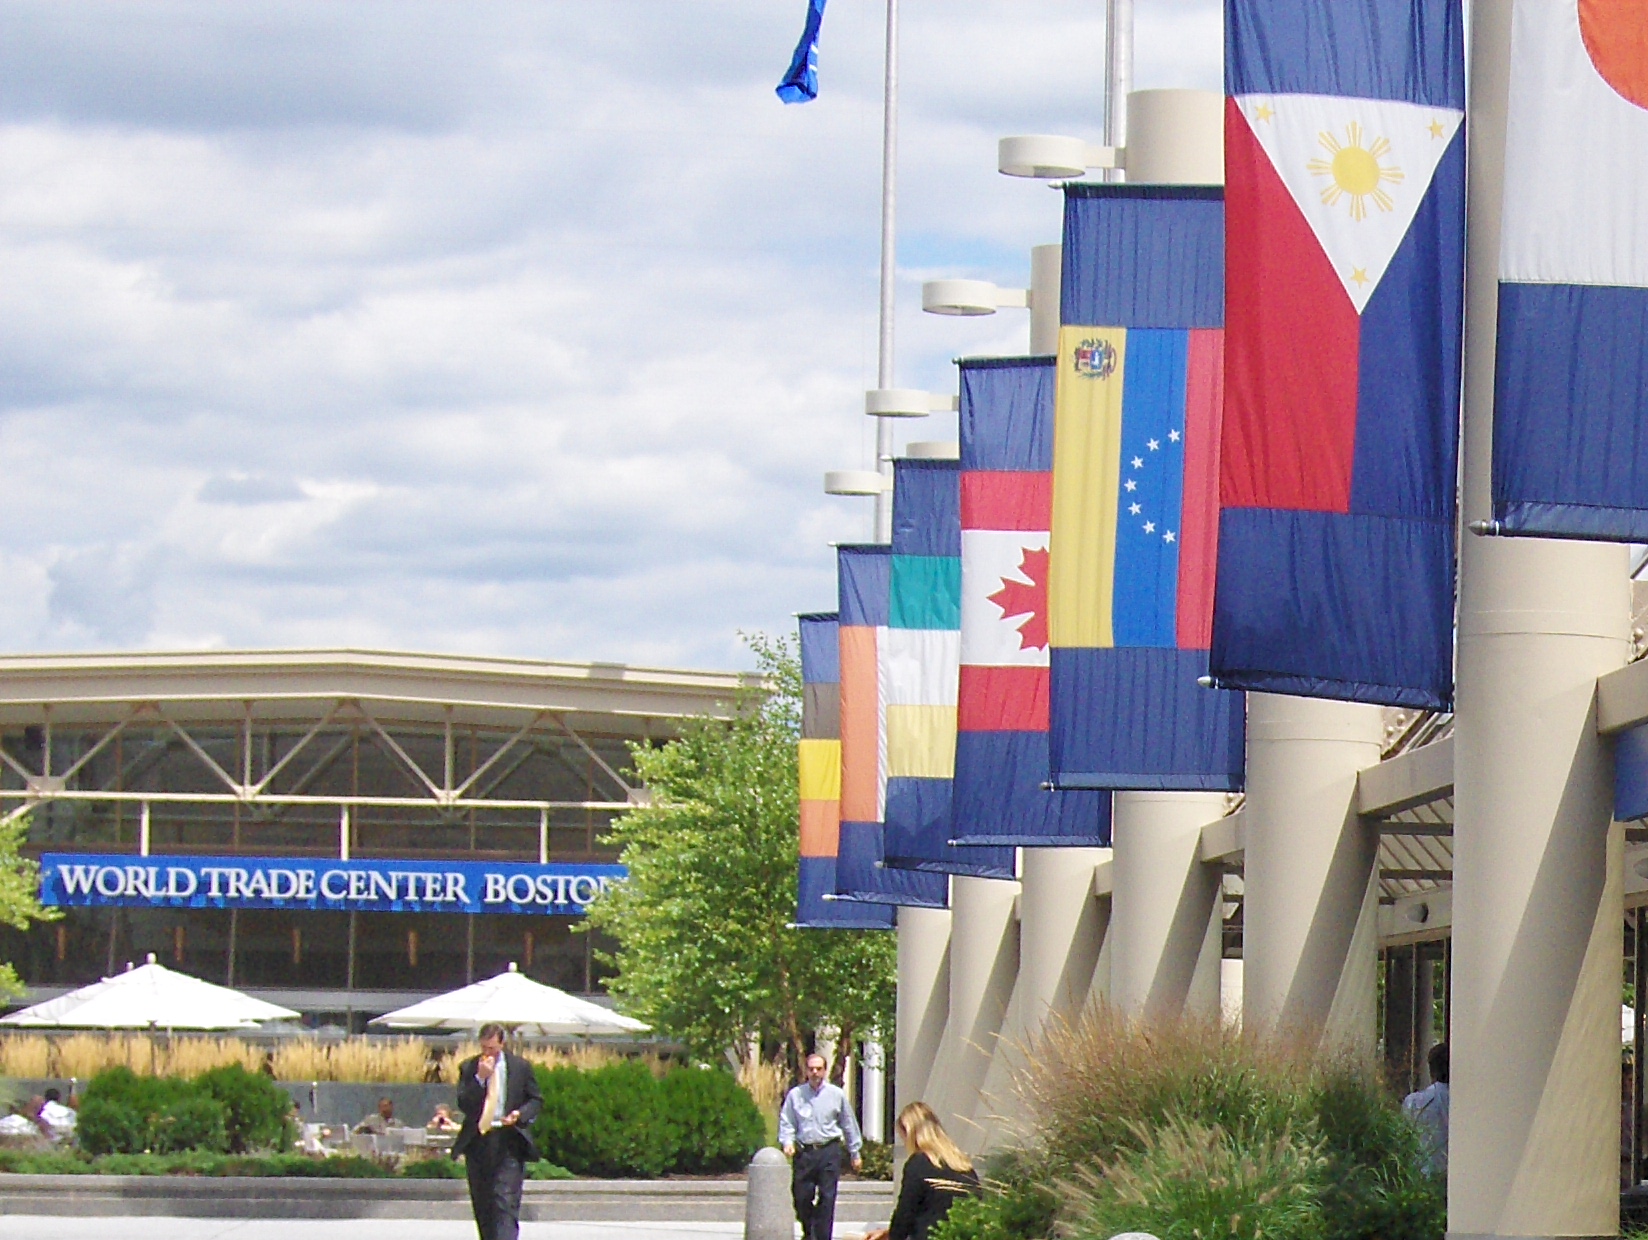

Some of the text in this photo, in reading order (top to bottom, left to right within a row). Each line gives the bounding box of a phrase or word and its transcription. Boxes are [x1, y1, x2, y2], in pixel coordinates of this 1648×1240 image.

[56, 864, 198, 898] WORLD
[200, 867, 318, 899] TRADE
[319, 869, 471, 905] CENTER
